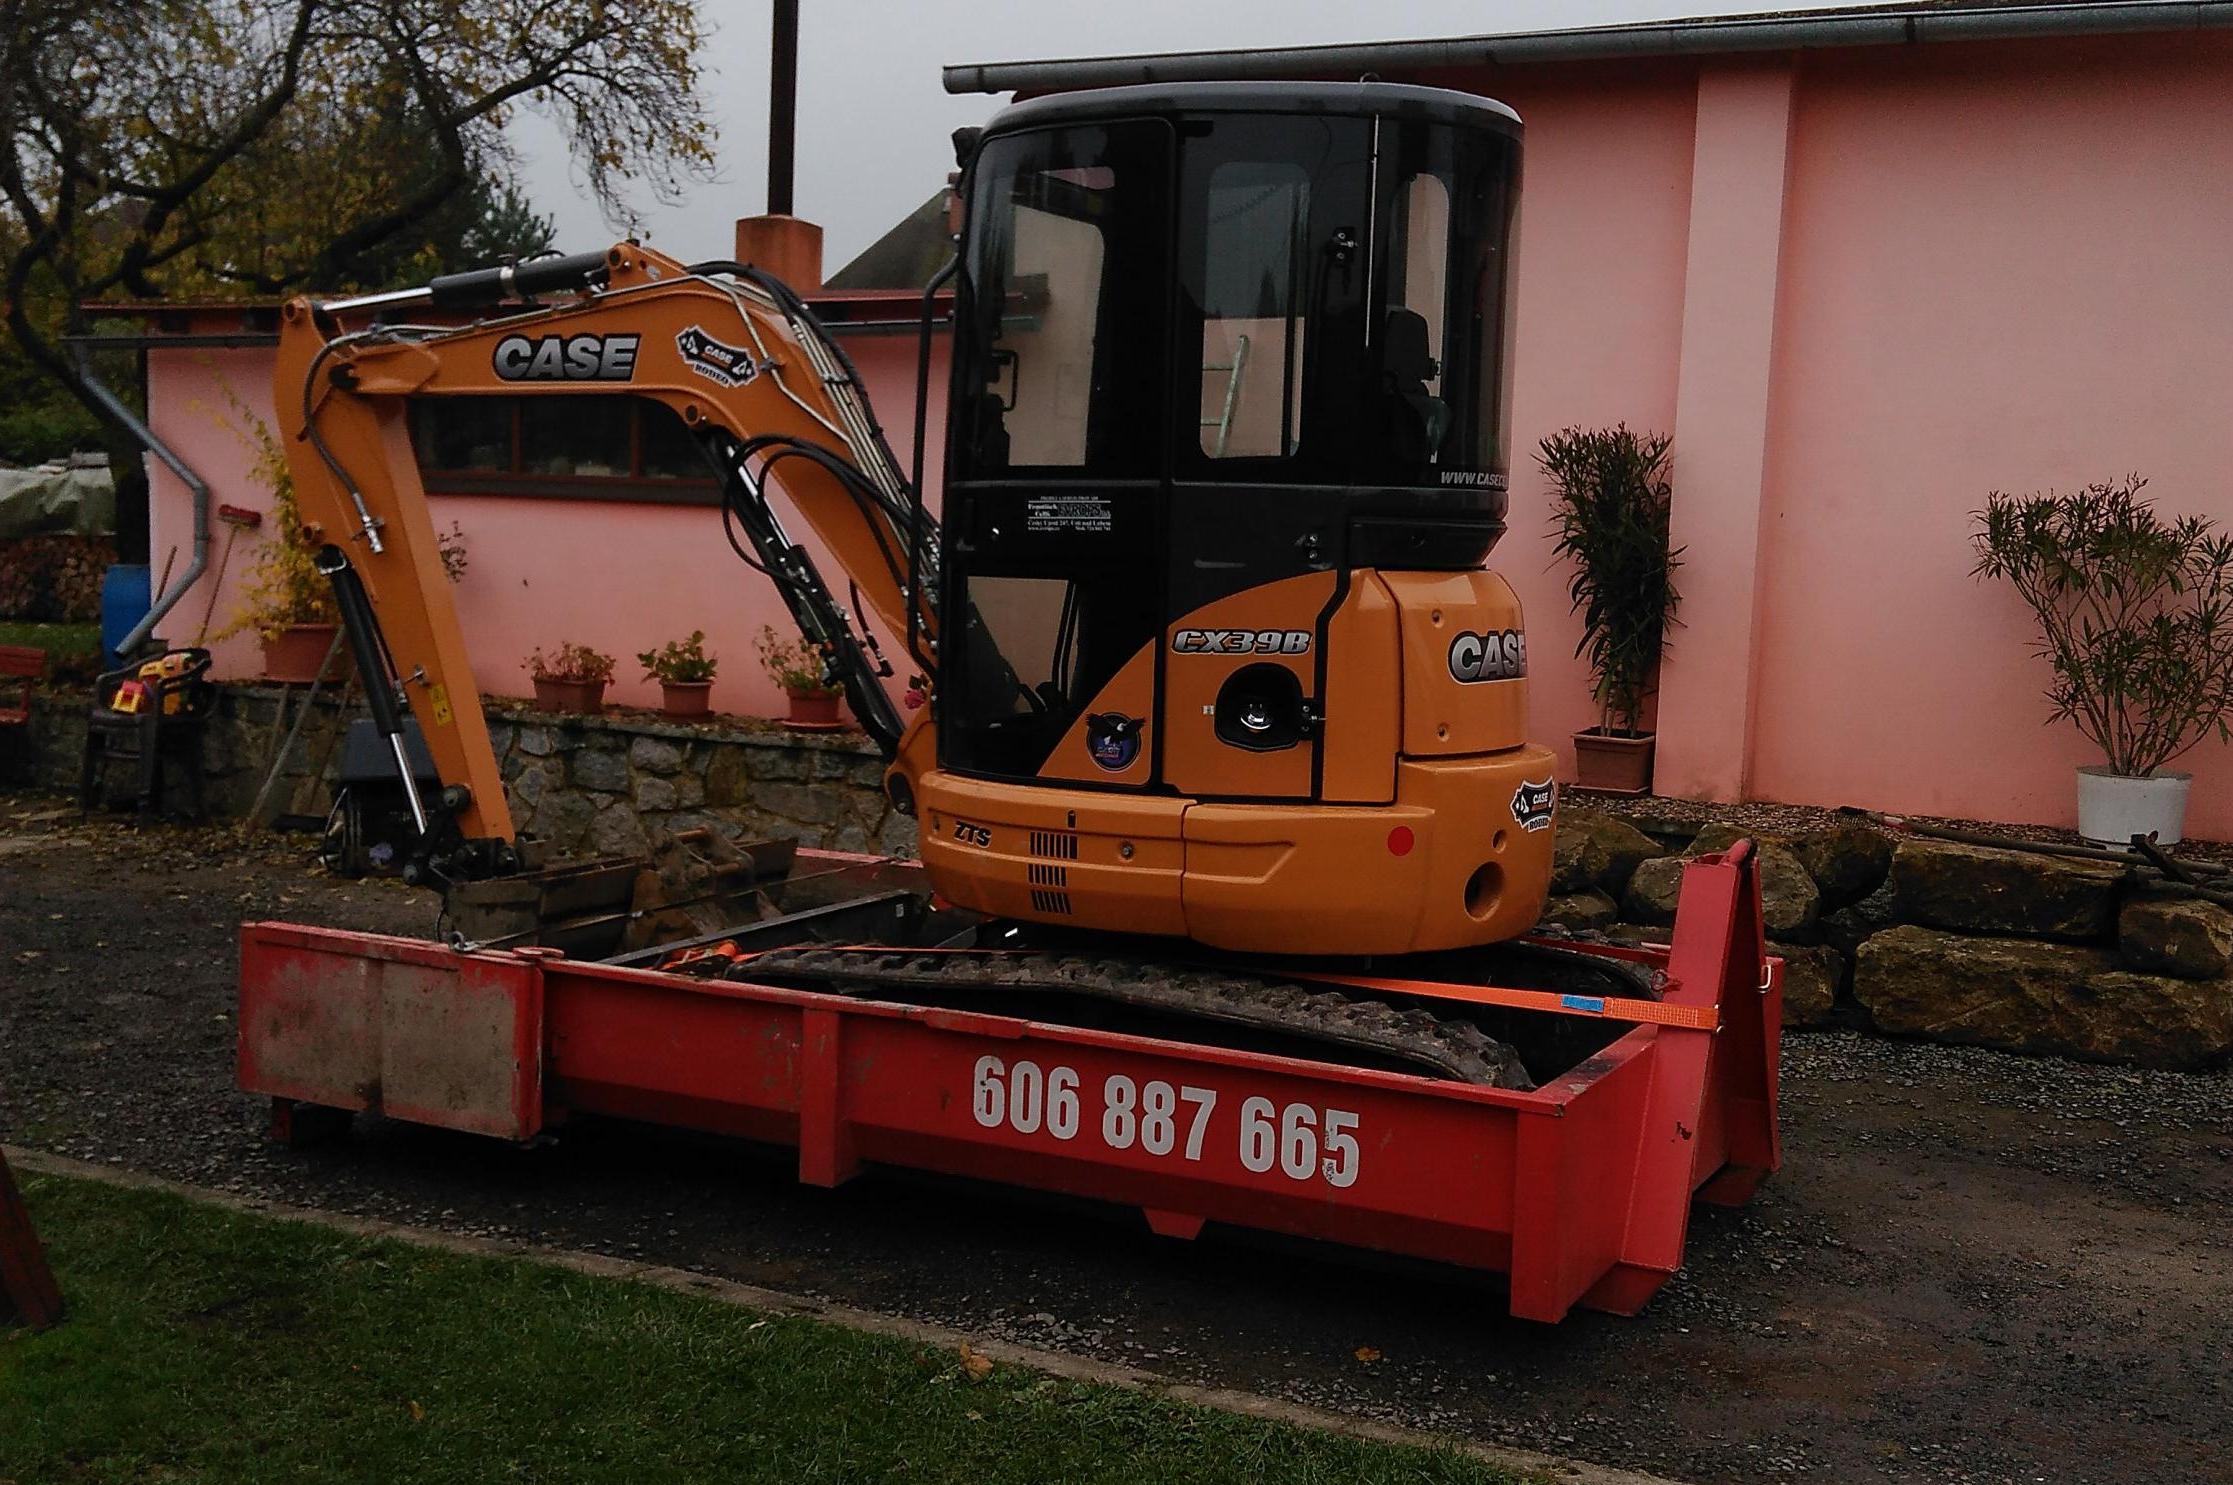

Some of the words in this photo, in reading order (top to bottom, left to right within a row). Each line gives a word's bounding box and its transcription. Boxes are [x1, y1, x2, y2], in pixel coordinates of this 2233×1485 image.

[494, 336, 638, 379] CASE
[704, 345, 734, 364] CASE
[1173, 629, 1312, 653] CX39B
[1450, 632, 1526, 681] CASE
[1533, 792, 1548, 804] CASE
[953, 820, 992, 848] ZTS
[973, 1055, 1080, 1140] 606
[1102, 1074, 1217, 1161] 887
[1239, 1096, 1360, 1188] 665
